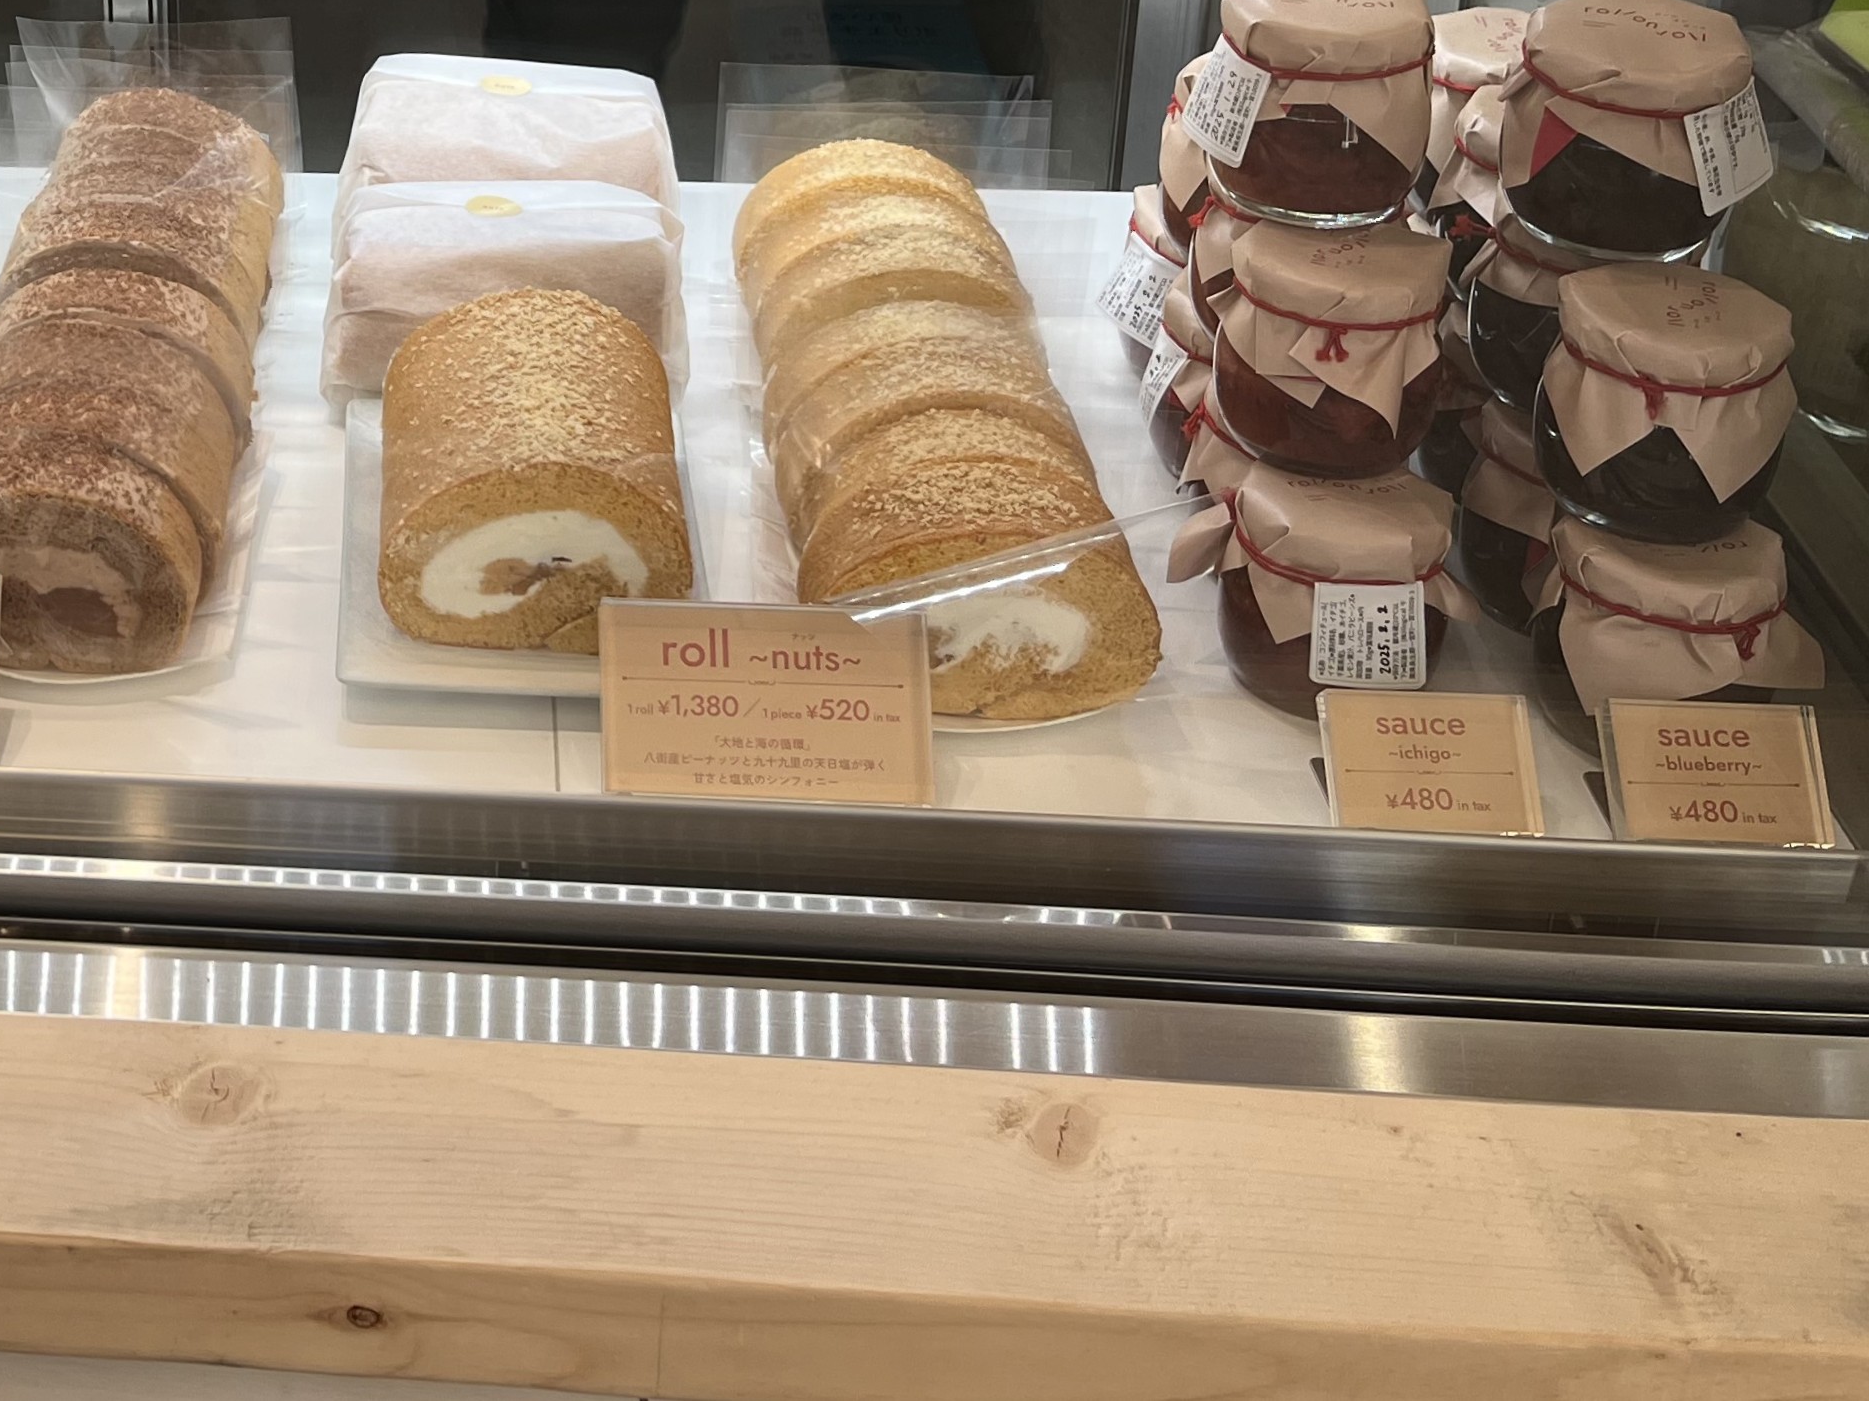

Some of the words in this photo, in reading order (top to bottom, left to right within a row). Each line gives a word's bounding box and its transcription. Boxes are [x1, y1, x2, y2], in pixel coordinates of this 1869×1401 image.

[662, 628, 730, 668] roll
[658, 695, 739, 717] ¥1,380
[806, 699, 870, 721] ¥520
[1376, 716, 1466, 736] sauce
[1658, 728, 1751, 748] sauce
[1385, 787, 1453, 811] ¥480
[1457, 801, 1469, 811] in
[1472, 801, 1491, 812] tax
[1669, 800, 1738, 823] ¥480
[1742, 812, 1755, 823] in
[1758, 813, 1778, 824] tax
